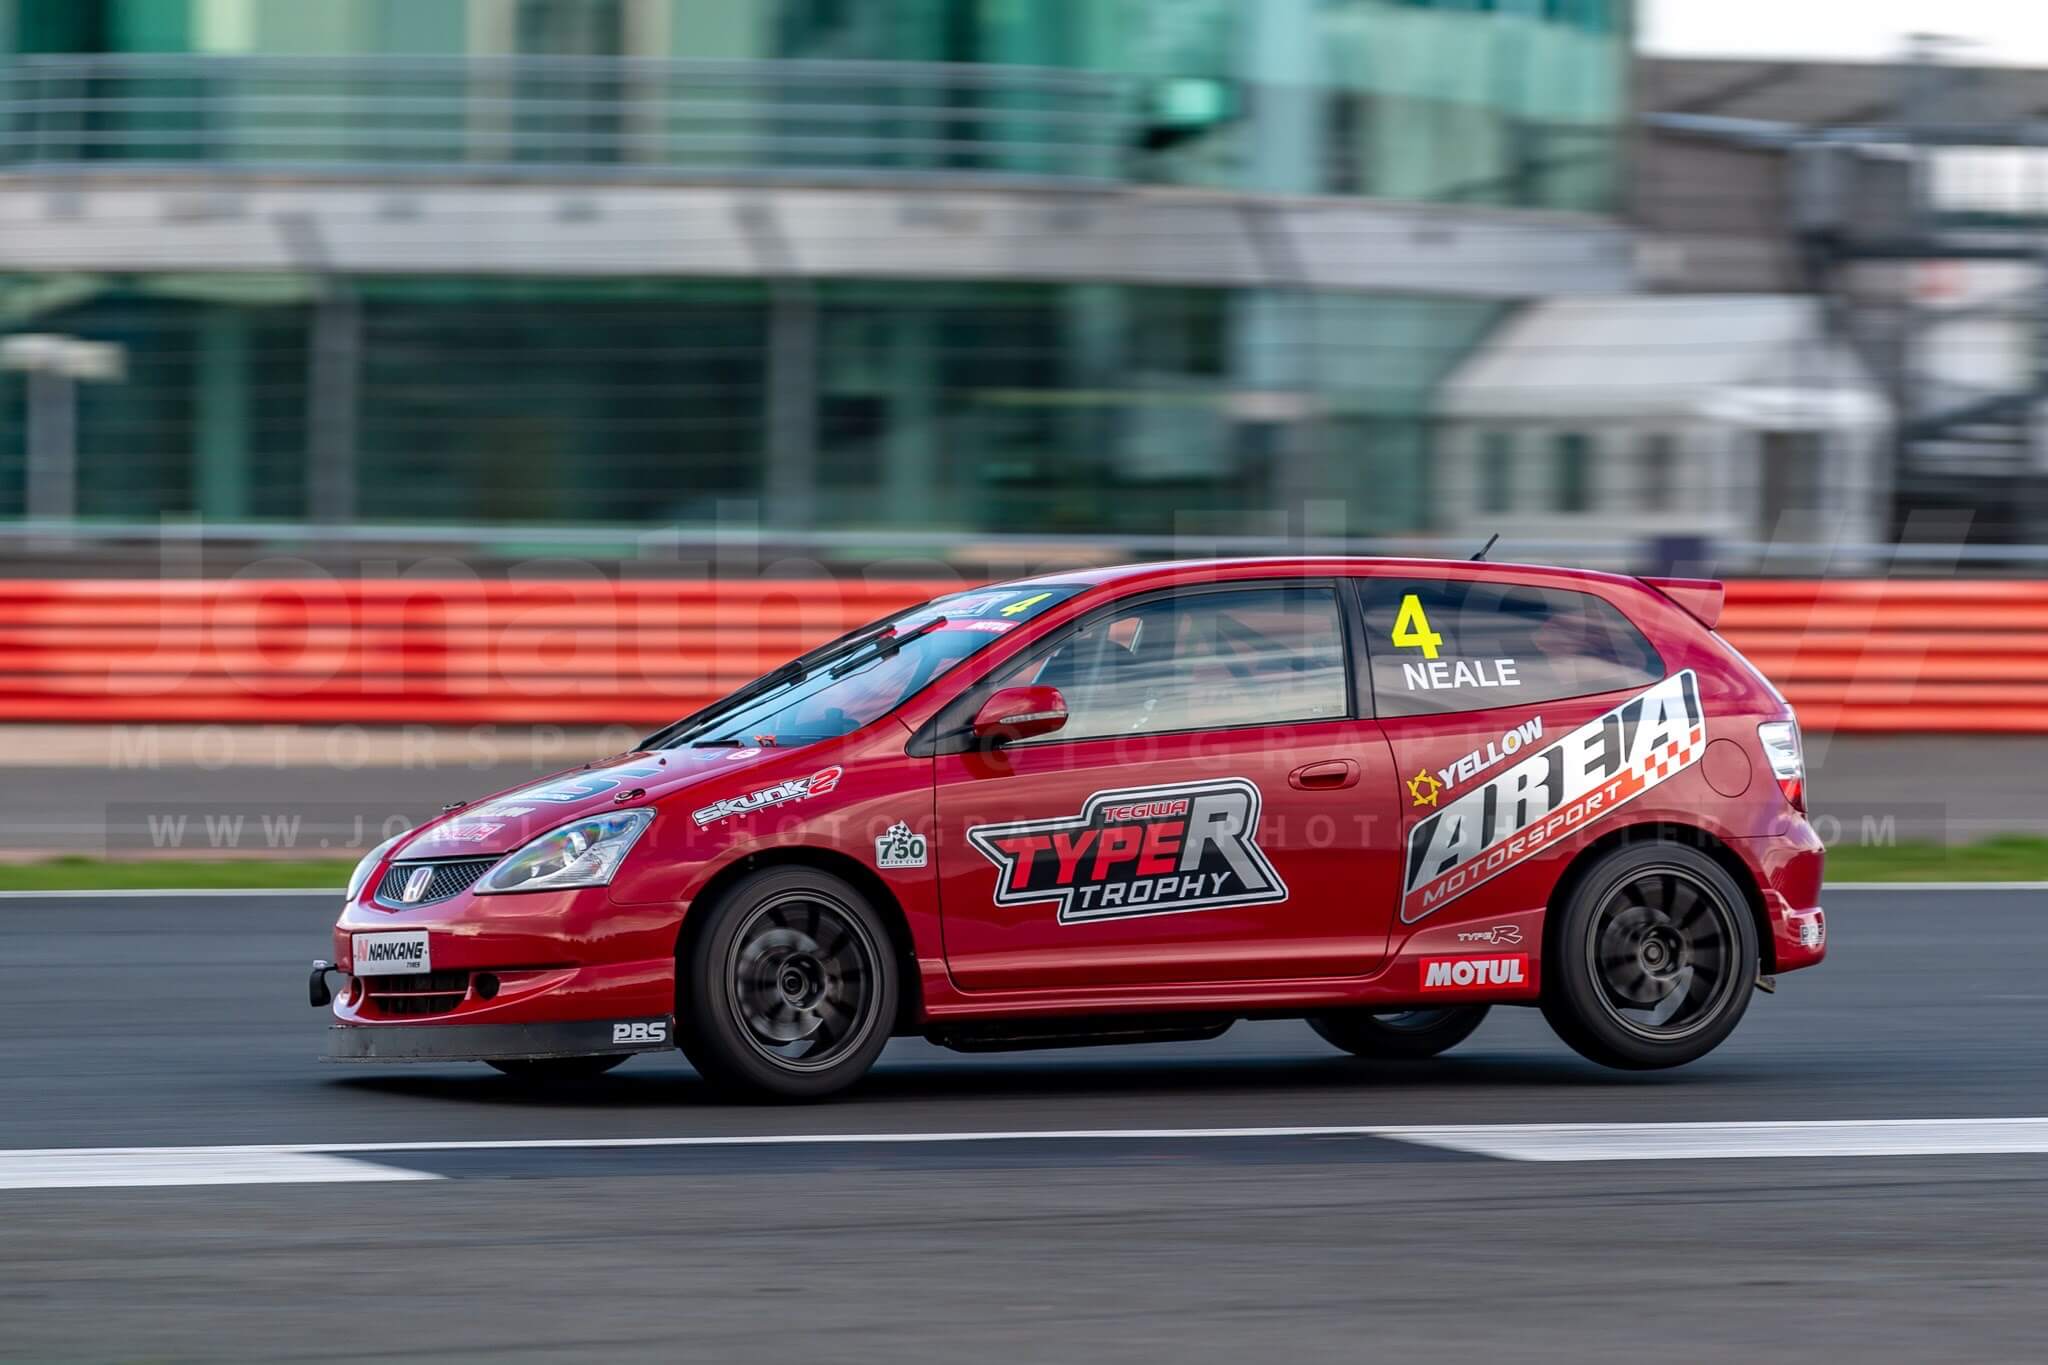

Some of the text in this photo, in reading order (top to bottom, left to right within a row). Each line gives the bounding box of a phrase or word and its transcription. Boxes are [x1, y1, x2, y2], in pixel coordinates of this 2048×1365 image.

[1000, 592, 1053, 617] 4
[1391, 594, 1443, 659] 4
[1402, 659, 1521, 690] NEALE
[1438, 716, 1543, 791] YELLOW
[1411, 674, 1701, 890] AREA
[1103, 800, 1188, 823] TEGIWA
[880, 839, 924, 859] 750
[1422, 780, 1622, 907] MOTORSPORT
[1079, 871, 1231, 908] TROPHY
[368, 941, 425, 961] NANKANG
[1424, 959, 1525, 987] MOTUL
